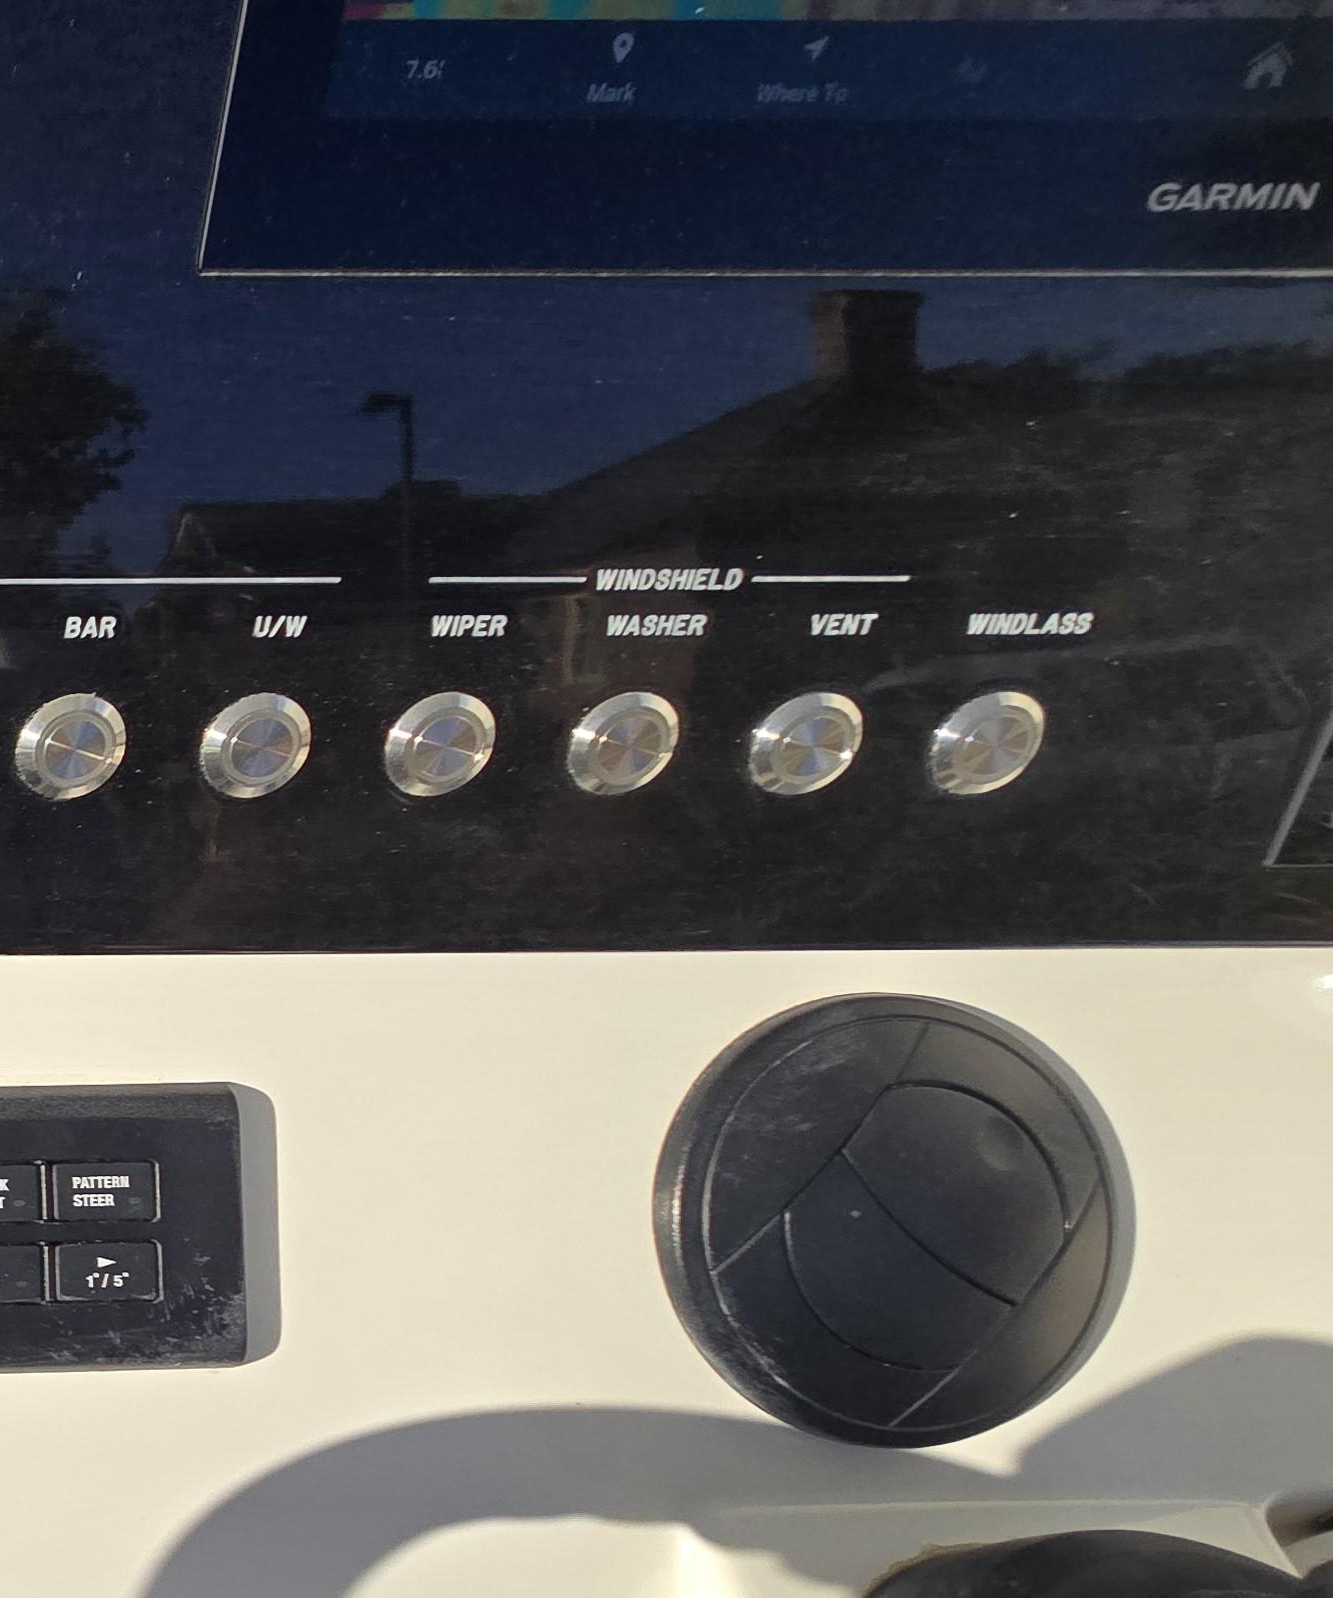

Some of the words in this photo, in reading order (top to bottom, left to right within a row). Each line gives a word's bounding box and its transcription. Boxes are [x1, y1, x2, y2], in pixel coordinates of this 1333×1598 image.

[586, 83, 636, 103] Mark
[757, 83, 819, 103] Where
[824, 83, 848, 102] To
[1147, 182, 1321, 212] GARMIN
[595, 568, 744, 592] WINDSHIELD
[63, 616, 117, 639] BAR
[252, 615, 308, 638] U/W
[431, 614, 508, 638] WIPER
[606, 614, 708, 637] WASHER
[810, 613, 879, 636] VENT
[966, 612, 1095, 636] WINDLASS
[72, 1176, 130, 1189] PATTERN
[73, 1194, 115, 1207] STEER
